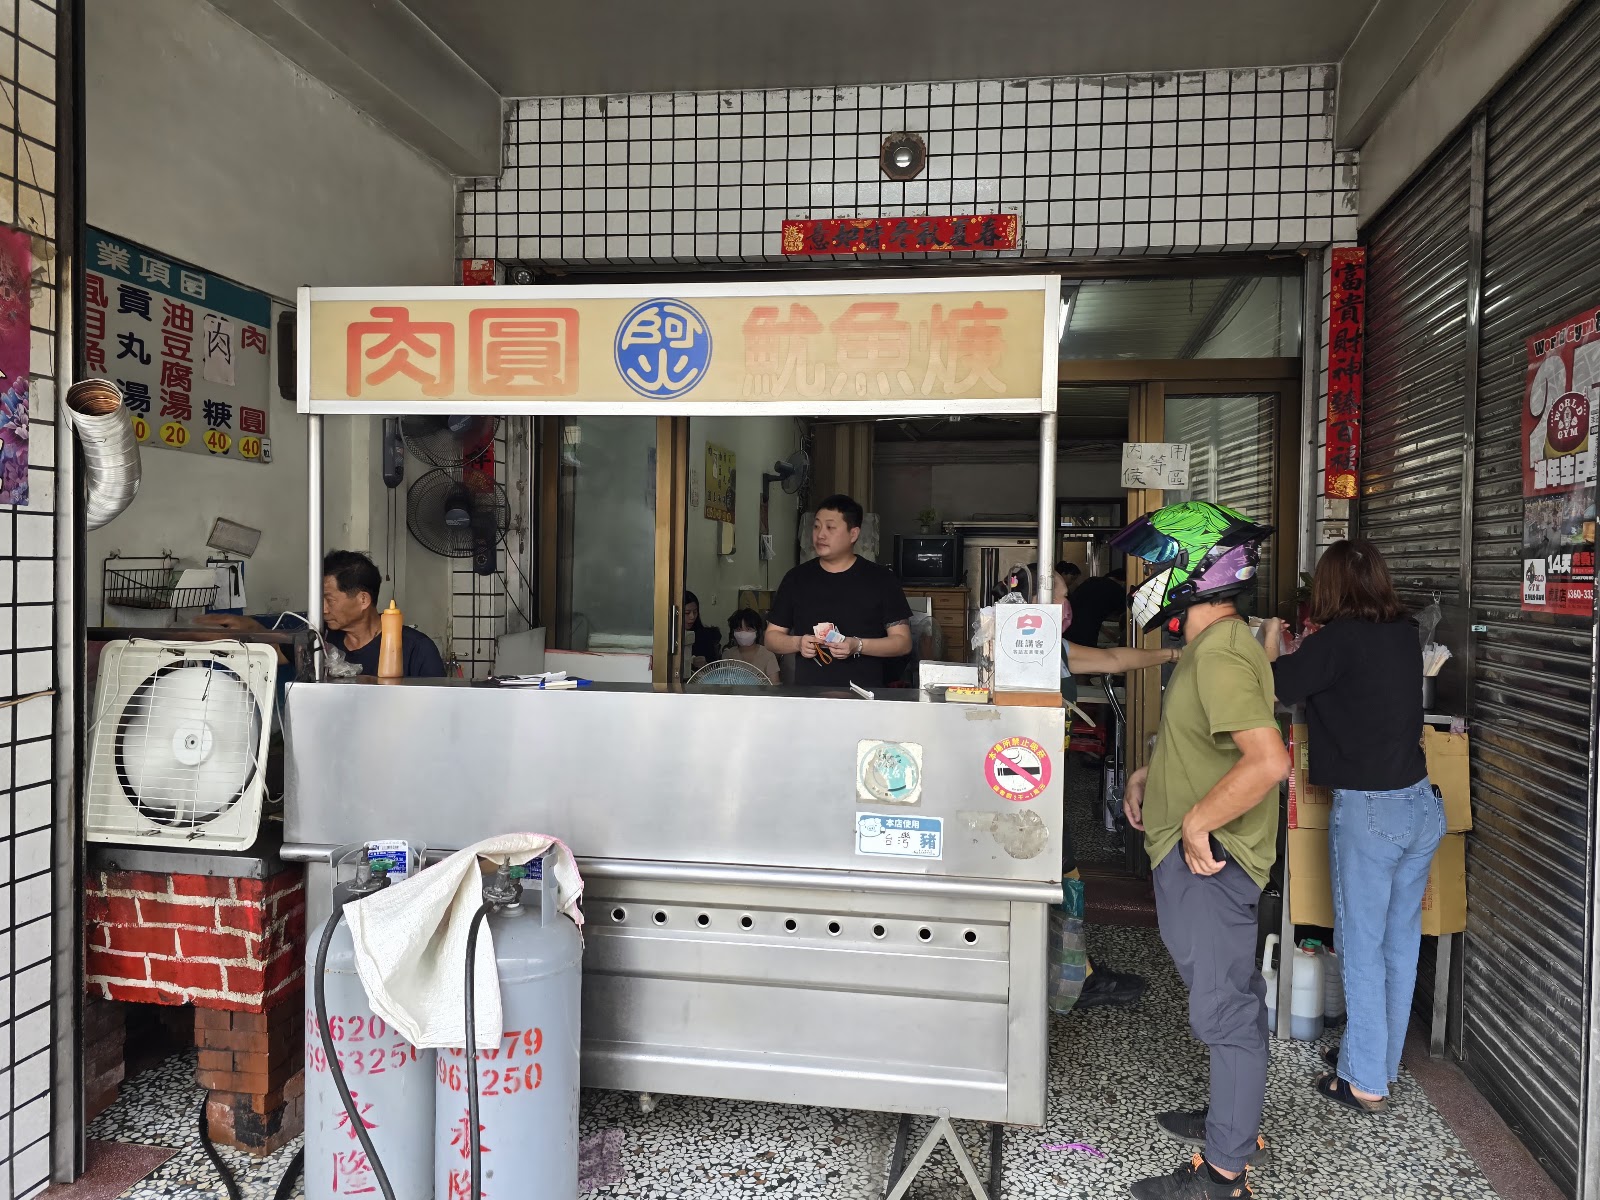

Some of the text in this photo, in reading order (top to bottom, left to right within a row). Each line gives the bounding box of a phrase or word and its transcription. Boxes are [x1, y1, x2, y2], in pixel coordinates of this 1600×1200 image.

[1533, 328, 1567, 358] World
[1566, 318, 1595, 343] Gym
[160, 298, 194, 422] 油豆腐湯
[345, 306, 580, 398] 肉圓
[1554, 398, 1583, 421] WORLD
[132, 421, 145, 438] 0
[165, 425, 186, 445] 20
[1557, 427, 1579, 440] GYM
[208, 432, 227, 450] 40
[242, 439, 259, 456] 40
[1547, 553, 1572, 574] 14天
[885, 819, 920, 829] 本店使用
